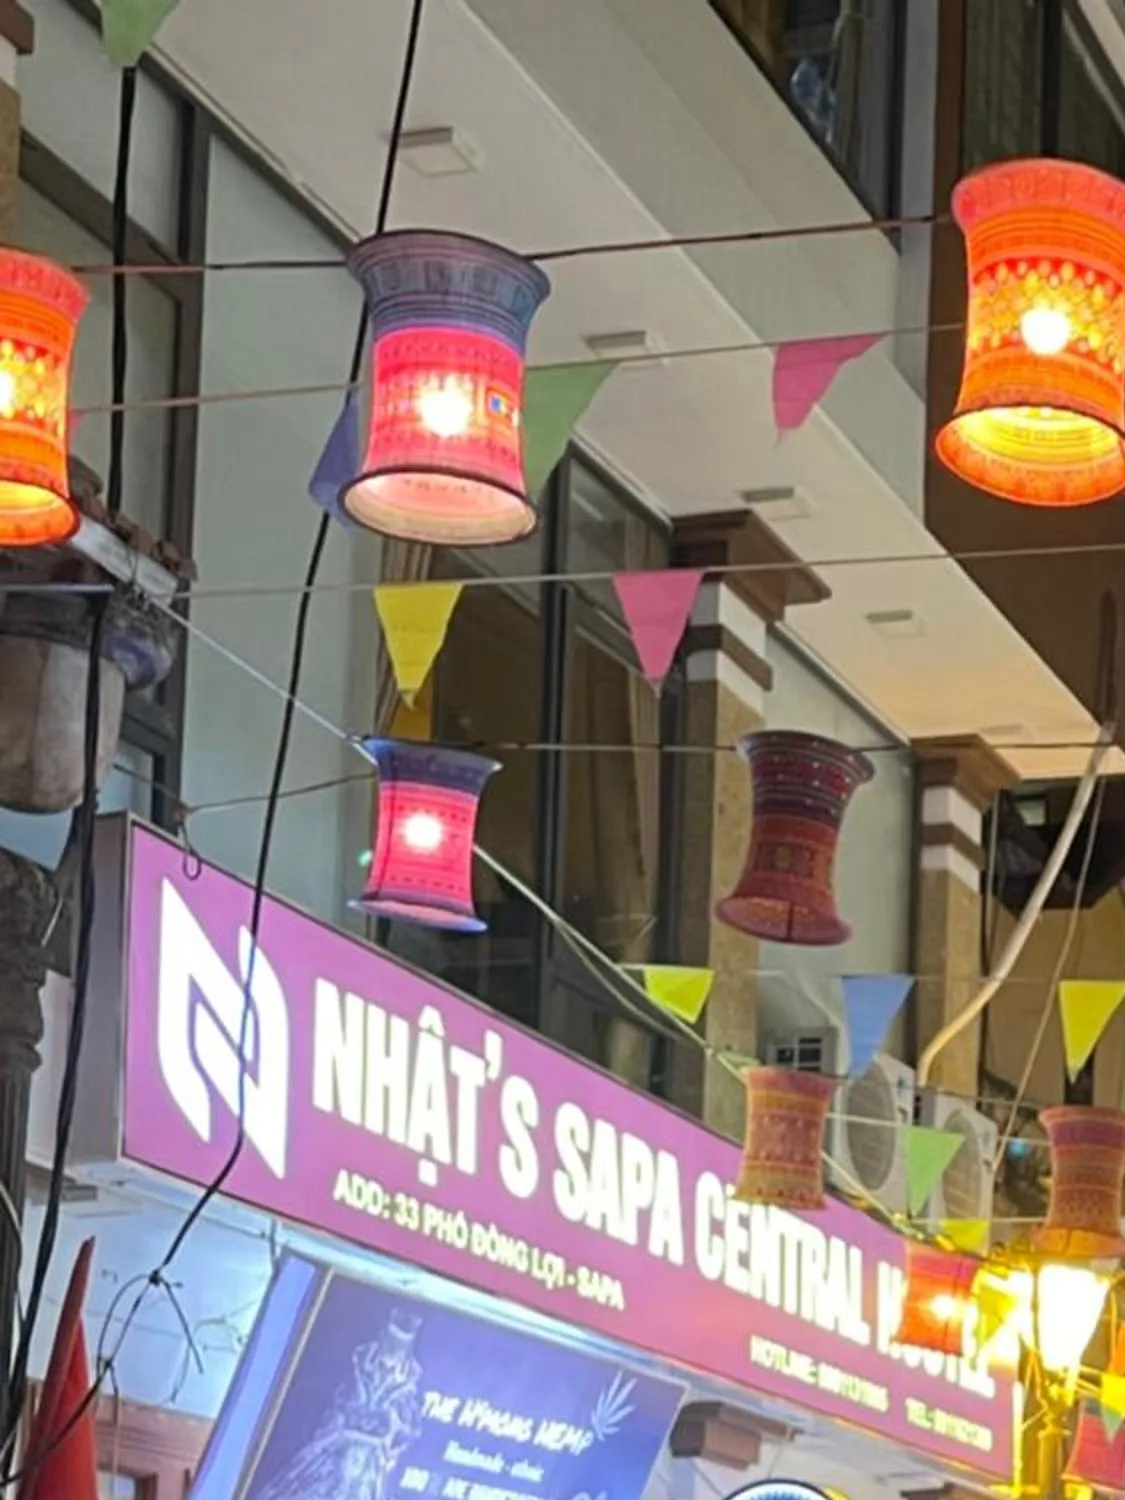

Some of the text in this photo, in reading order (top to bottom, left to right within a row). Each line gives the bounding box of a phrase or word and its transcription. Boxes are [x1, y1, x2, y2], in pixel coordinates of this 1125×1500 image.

[312, 976, 539, 1199] NHẬT'S
[553, 1101, 684, 1266] SAPA
[695, 1171, 871, 1346] CENTRAL
[333, 1168, 390, 1219] ADD:
[394, 1192, 418, 1231] 33
[576, 1266, 625, 1311] SAPA
